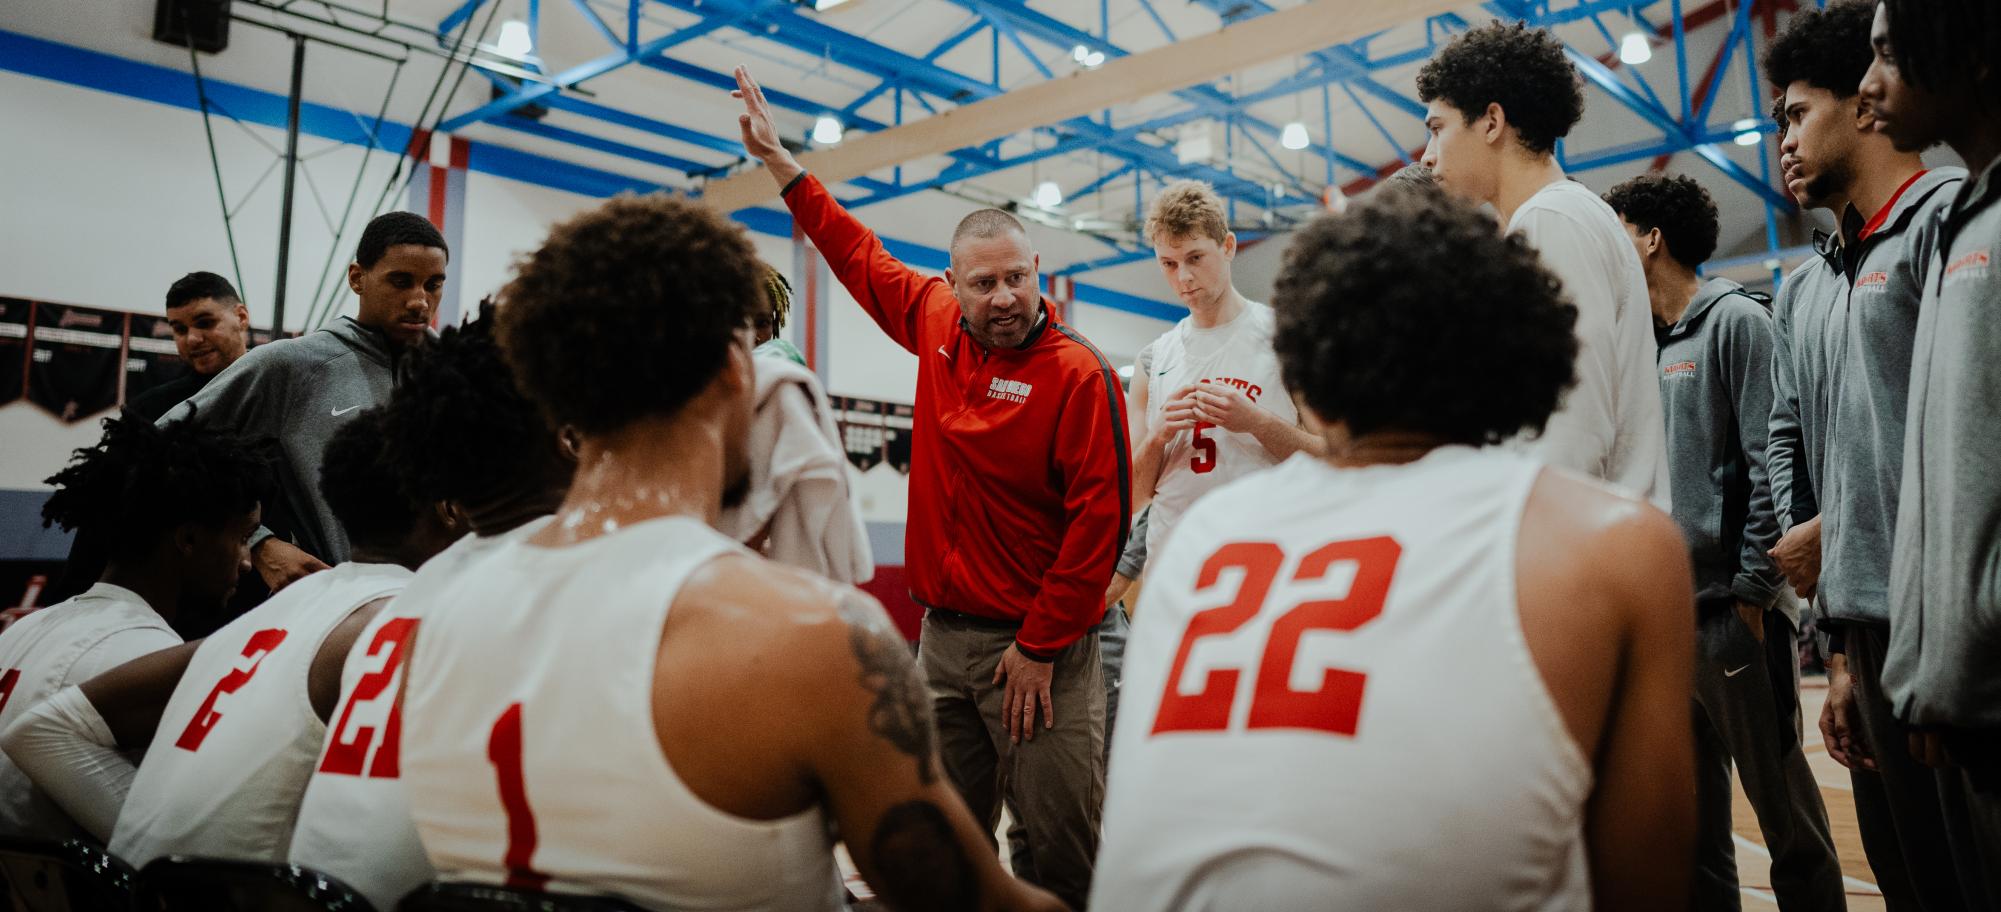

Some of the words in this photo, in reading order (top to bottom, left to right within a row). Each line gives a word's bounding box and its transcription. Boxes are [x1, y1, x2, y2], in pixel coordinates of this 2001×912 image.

[1190, 421, 1217, 474] 5
[175, 628, 289, 753] 2
[1150, 535, 1402, 737] 22
[487, 701, 546, 888] 1
